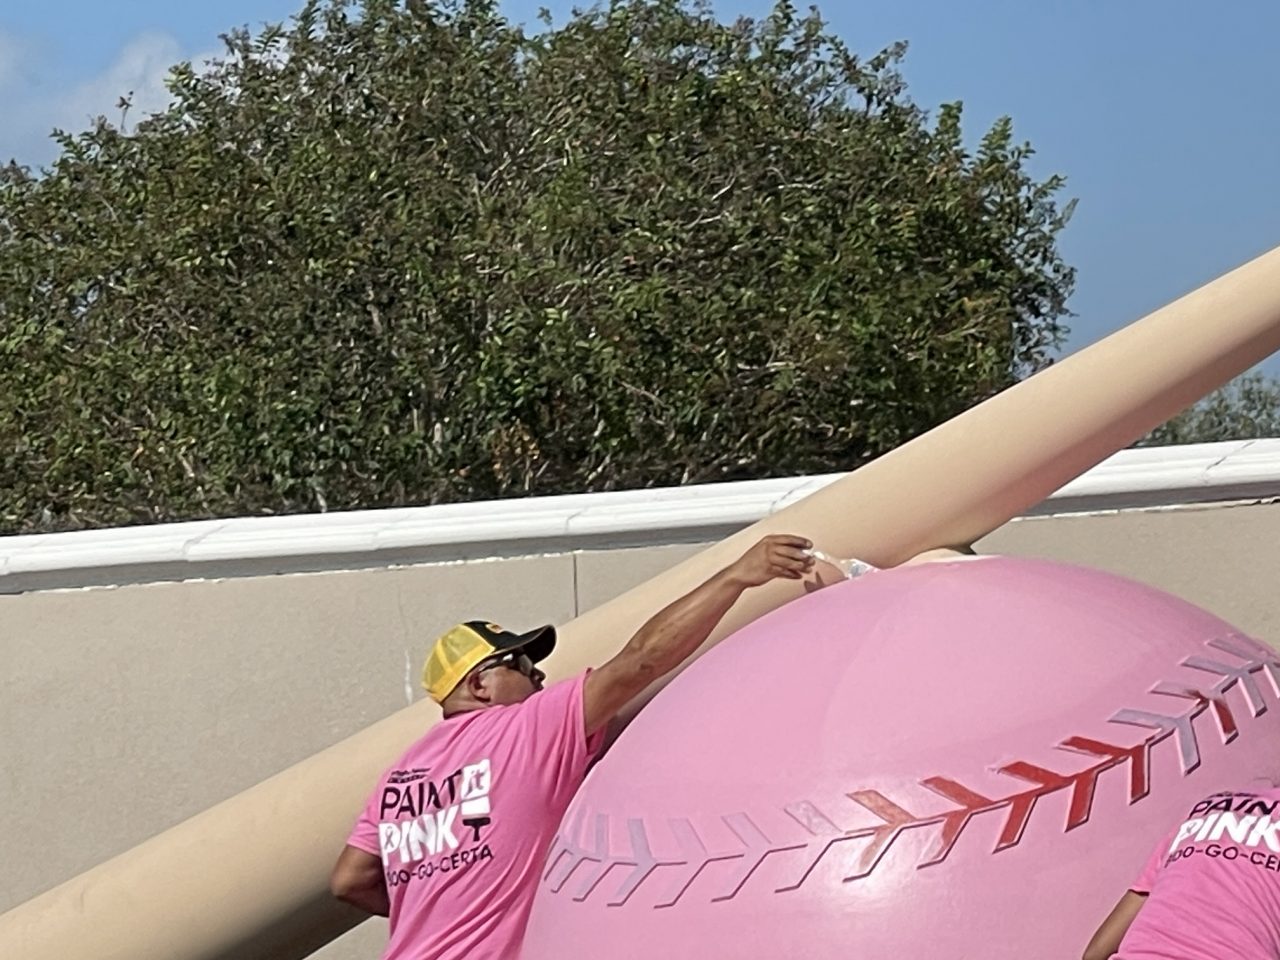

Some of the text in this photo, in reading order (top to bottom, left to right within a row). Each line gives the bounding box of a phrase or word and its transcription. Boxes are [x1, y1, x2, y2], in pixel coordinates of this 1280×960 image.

[380, 768, 487, 820] PAINT it
[378, 804, 460, 867] PINK
